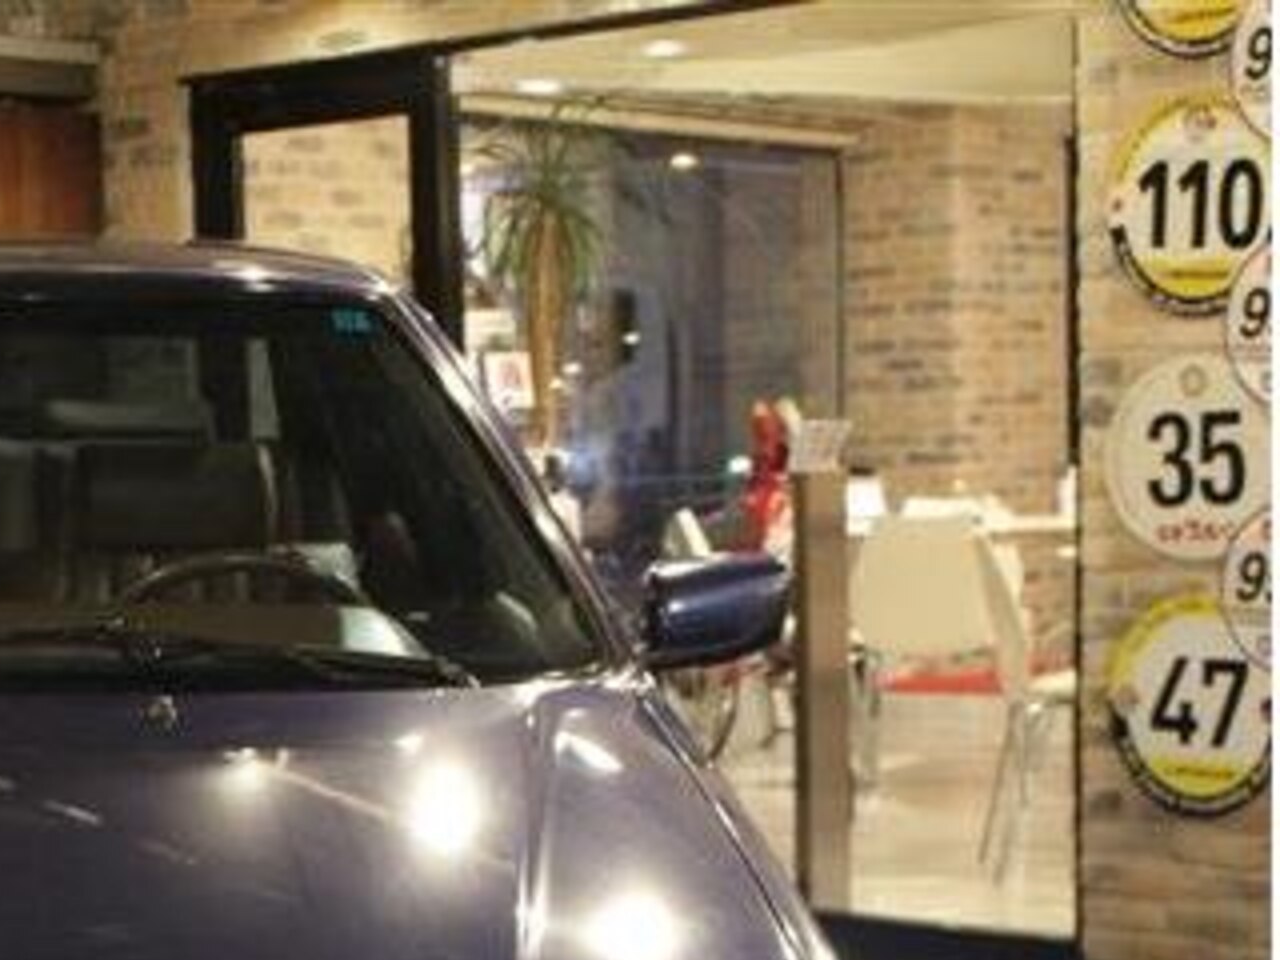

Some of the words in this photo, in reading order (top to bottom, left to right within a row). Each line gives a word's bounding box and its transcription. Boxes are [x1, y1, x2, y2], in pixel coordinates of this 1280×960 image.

[1138, 158, 1264, 249] 110
[1148, 411, 1245, 507] 35
[1236, 551, 1272, 602] 9
[1151, 656, 1249, 746] 47
